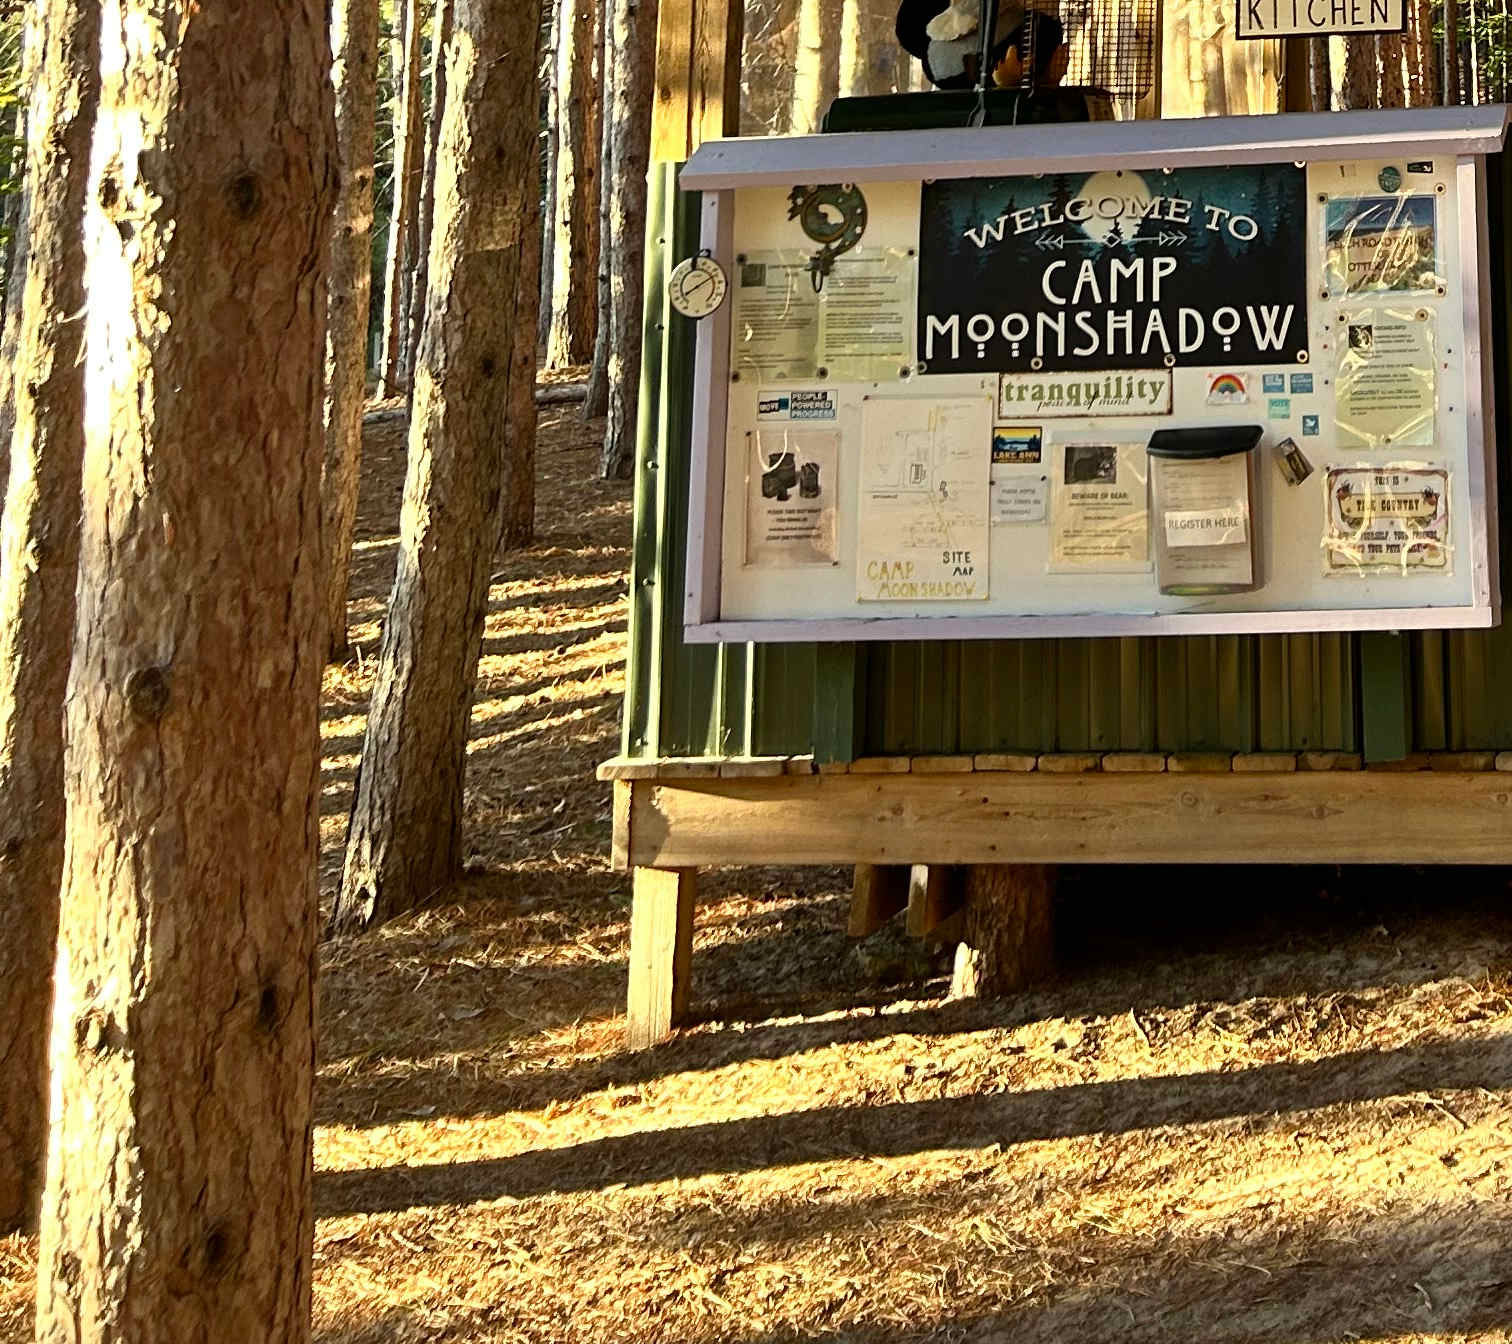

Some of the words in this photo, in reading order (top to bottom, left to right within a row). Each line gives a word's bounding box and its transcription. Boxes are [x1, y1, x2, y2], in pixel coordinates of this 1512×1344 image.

[963, 195, 1193, 250] WELCOME
[1203, 204, 1259, 242] TO
[1041, 256, 1177, 306] CAMP
[924, 304, 1295, 360] MOONSHADOW
[1004, 375, 1166, 406] tranquility
[1168, 518, 1212, 529] REGISTER
[1214, 516, 1240, 528] HERE
[866, 559, 915, 581] CAMP
[942, 551, 972, 564] SITE
[952, 566, 974, 577] MAP
